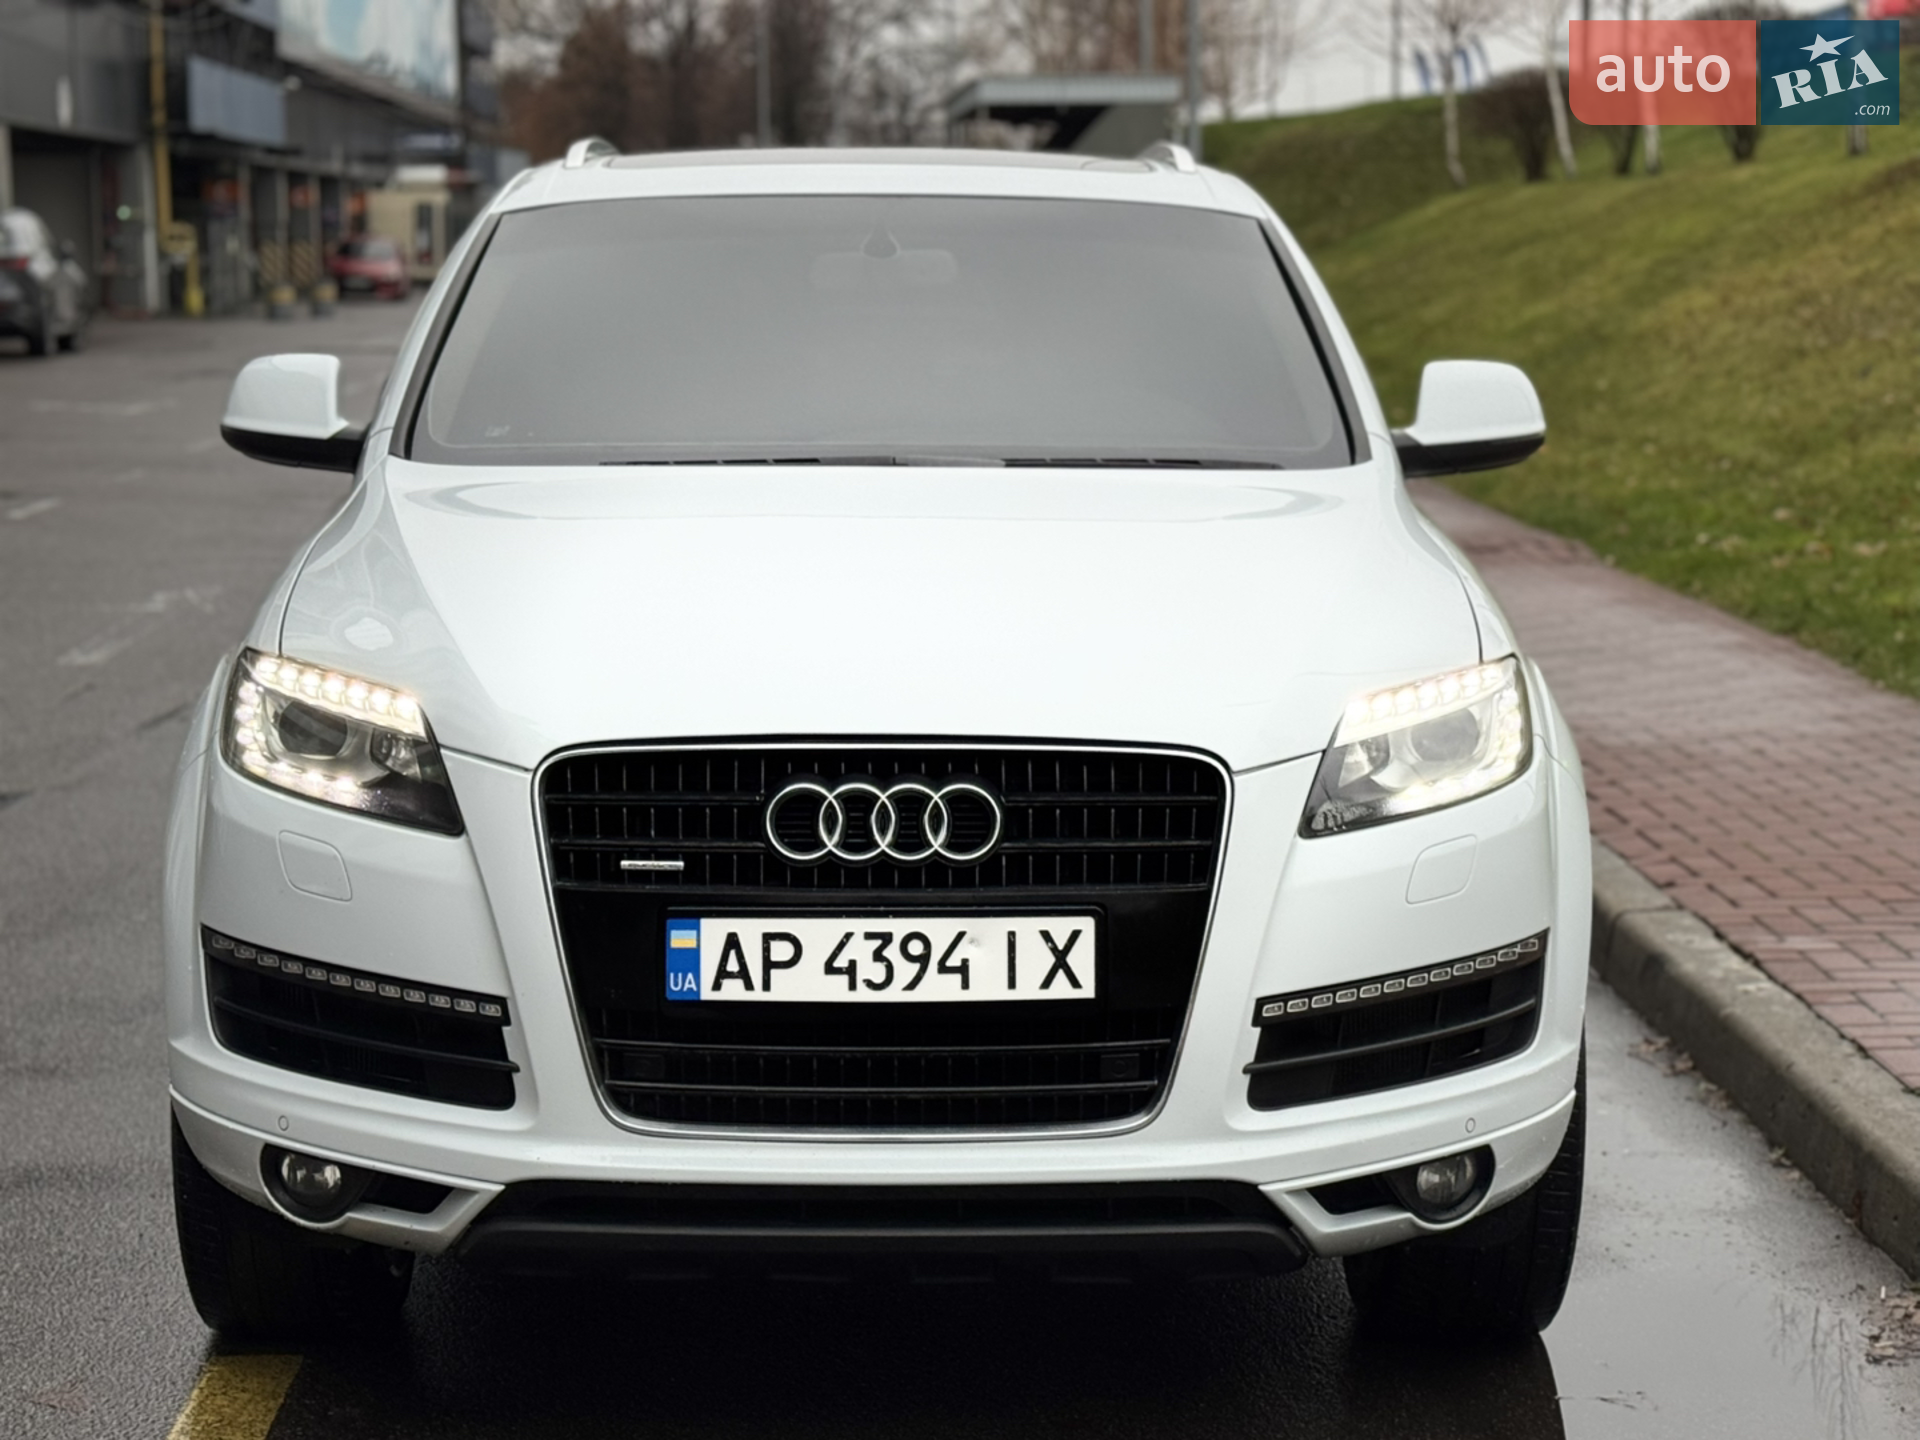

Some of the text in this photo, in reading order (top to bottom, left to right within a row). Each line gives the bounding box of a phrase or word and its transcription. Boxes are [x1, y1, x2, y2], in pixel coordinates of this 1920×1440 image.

[711, 929, 1083, 992] AP 4394 IX
[669, 972, 698, 991] UA
